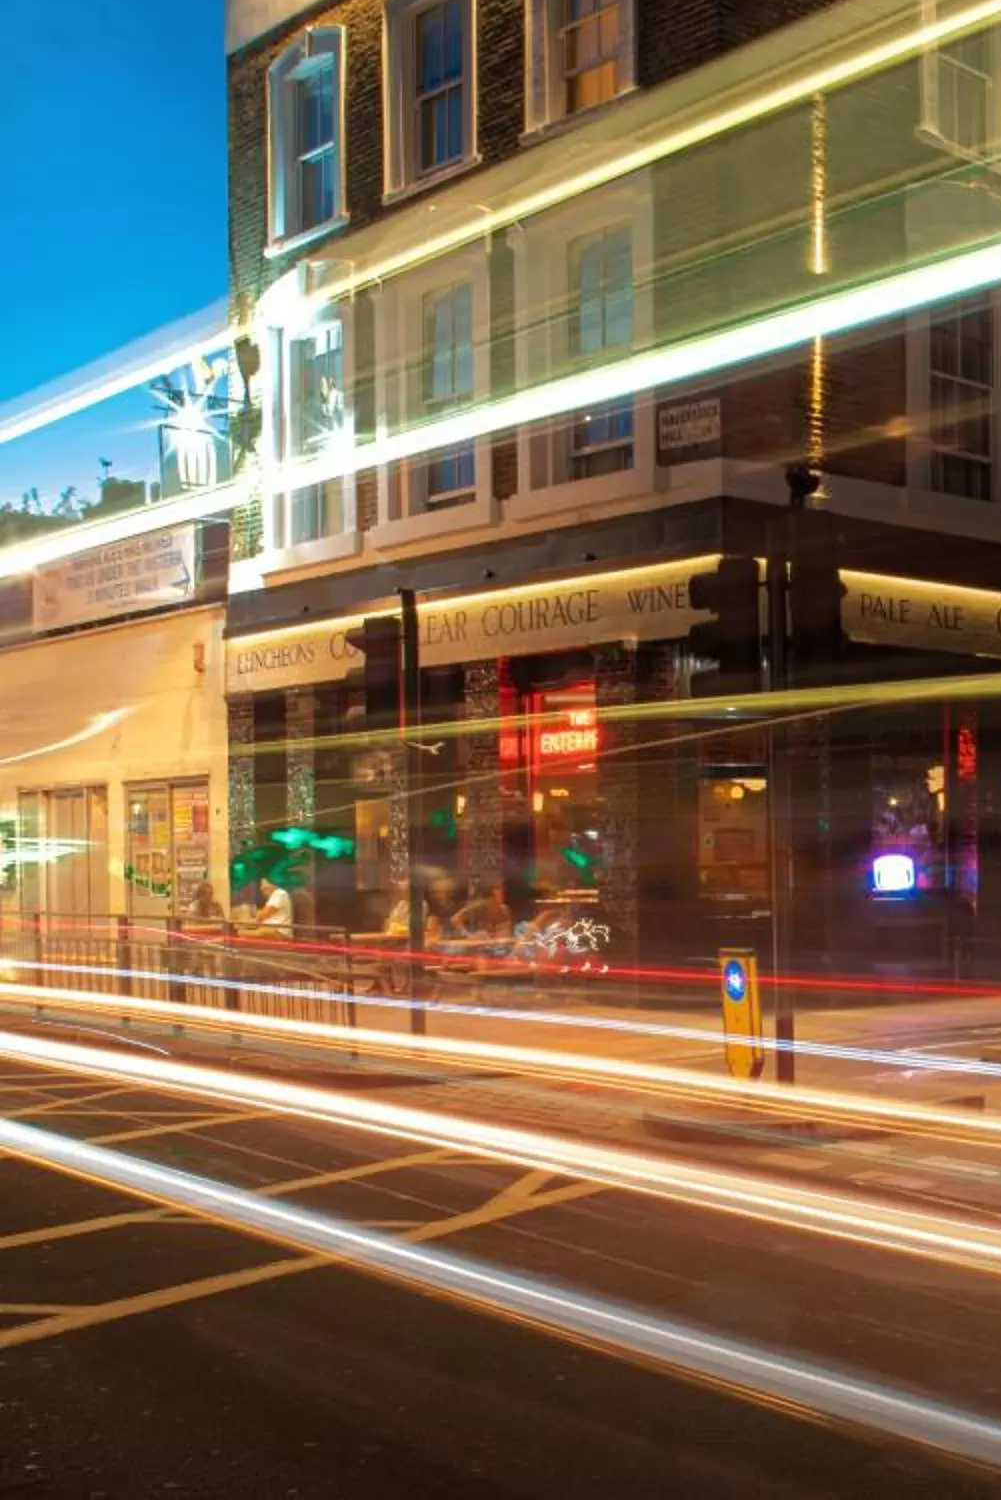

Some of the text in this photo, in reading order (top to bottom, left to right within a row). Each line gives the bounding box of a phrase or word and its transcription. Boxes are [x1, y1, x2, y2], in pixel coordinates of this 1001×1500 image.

[236, 640, 315, 675] LUNCHEONS
[422, 610, 468, 646] EAR
[480, 589, 600, 638] COURAGE
[860, 592, 910, 625] PALE
[927, 604, 965, 631] ALE
